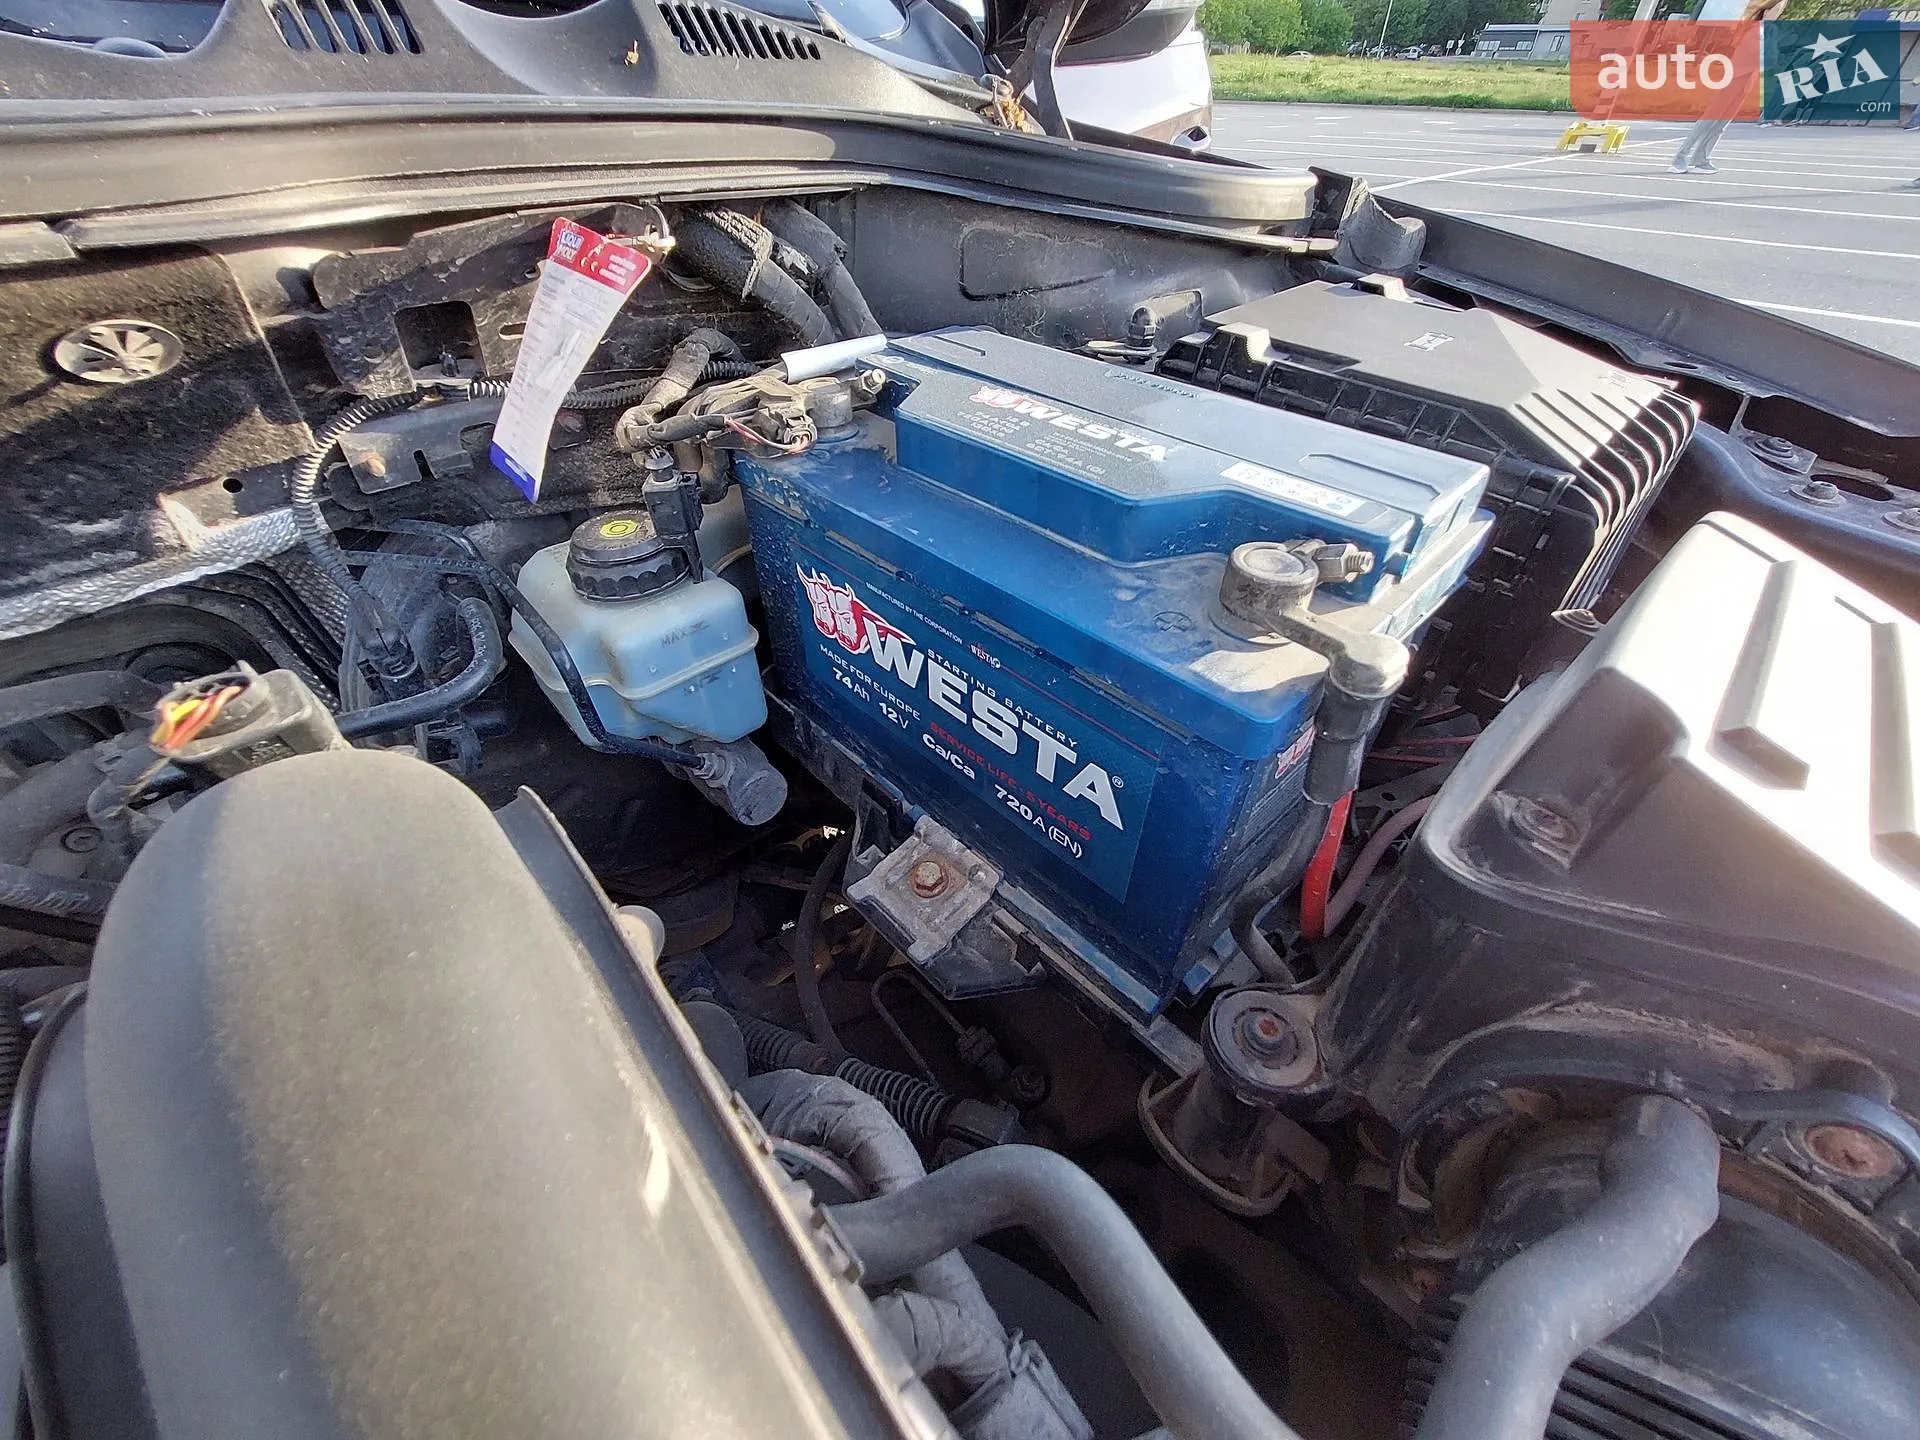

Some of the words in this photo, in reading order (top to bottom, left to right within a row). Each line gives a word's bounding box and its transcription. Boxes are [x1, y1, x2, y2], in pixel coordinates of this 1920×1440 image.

[1014, 401, 1169, 462] WESTA
[661, 627, 688, 648] MAX
[913, 608, 924, 621] THE
[924, 616, 963, 645] CORPORATION
[820, 643, 849, 670] MADE
[849, 665, 872, 686] FOR
[873, 681, 921, 721] EUROPE
[927, 648, 996, 697] STARTING
[1004, 697, 1078, 748] BATTERY
[863, 614, 1123, 831] WESTA
[879, 702, 909, 729] 12V
[922, 733, 976, 780] Ca/Ca
[930, 721, 985, 764] SERVICE
[987, 763, 1018, 788] LIFE
[1038, 797, 1092, 841] YEARS
